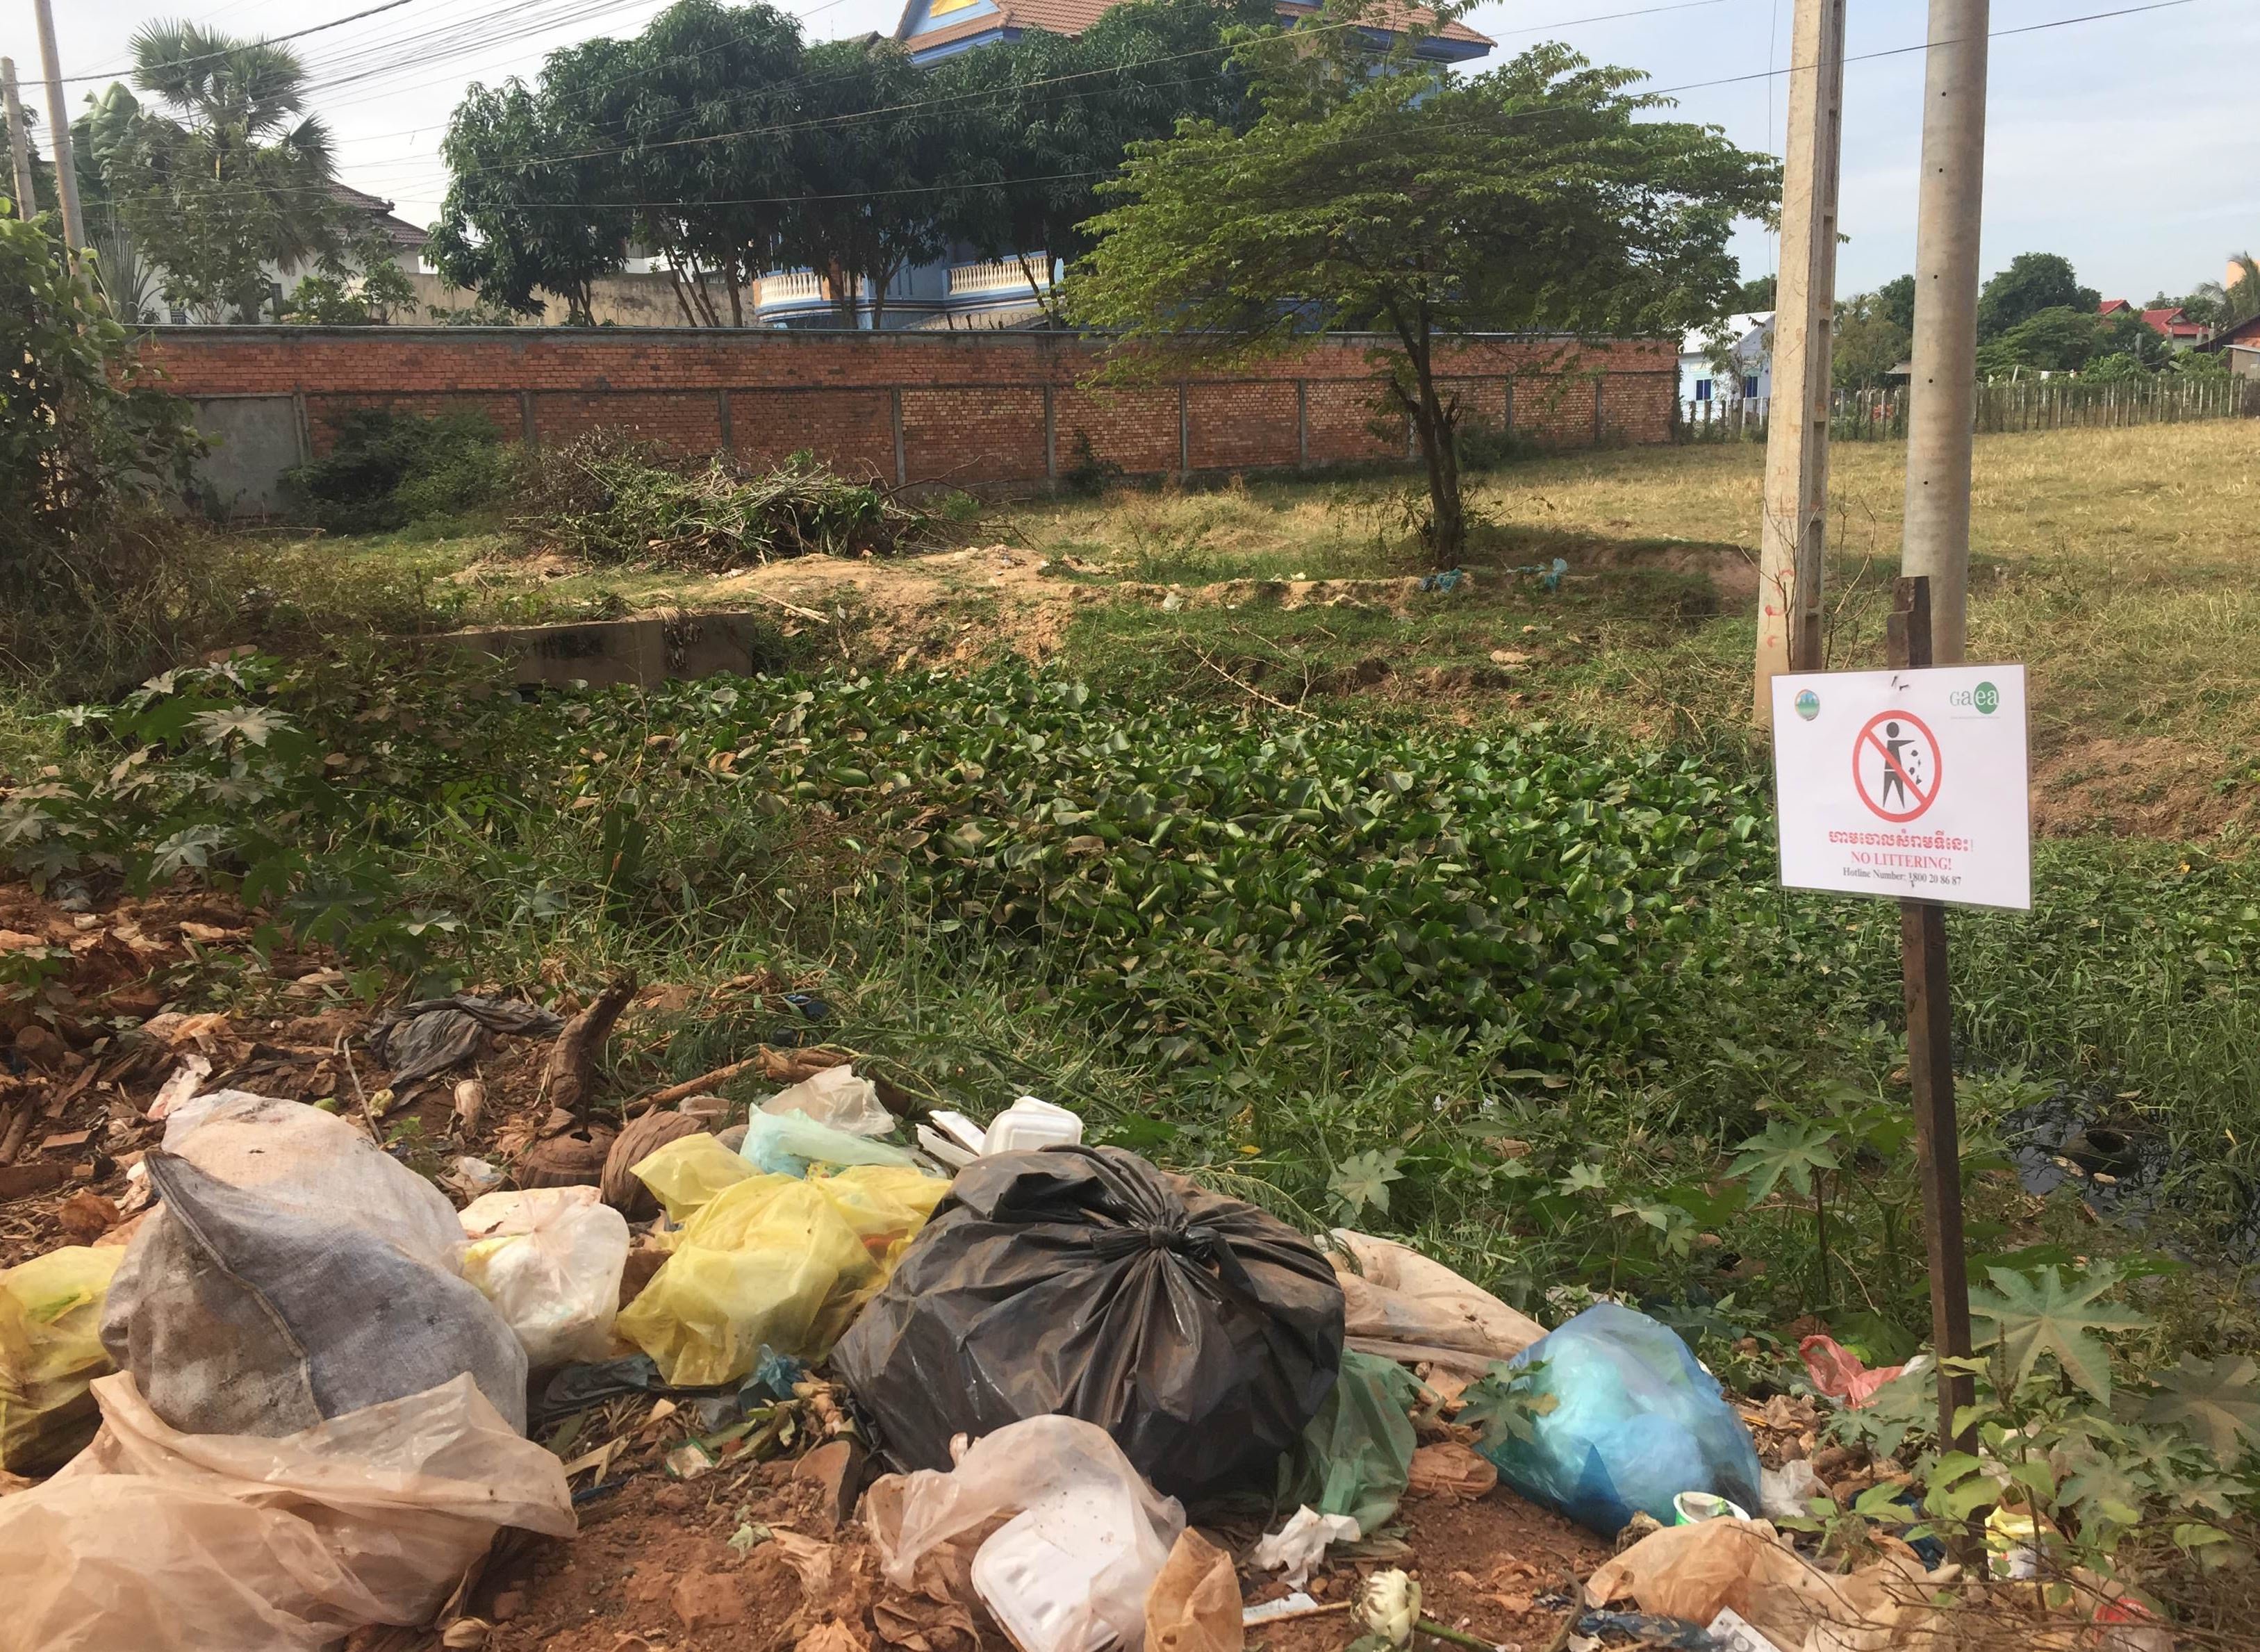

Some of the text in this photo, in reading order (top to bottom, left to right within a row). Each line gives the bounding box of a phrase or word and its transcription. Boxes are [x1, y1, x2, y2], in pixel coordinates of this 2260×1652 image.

[1851, 851, 1952, 870] NO LITTERING!
[1843, 867, 1871, 878] Hotline
[1874, 870, 1906, 882] Number:
[1929, 873, 1938, 884] 20
[1940, 875, 1950, 884] 86
[1952, 876, 1961, 886] 87
